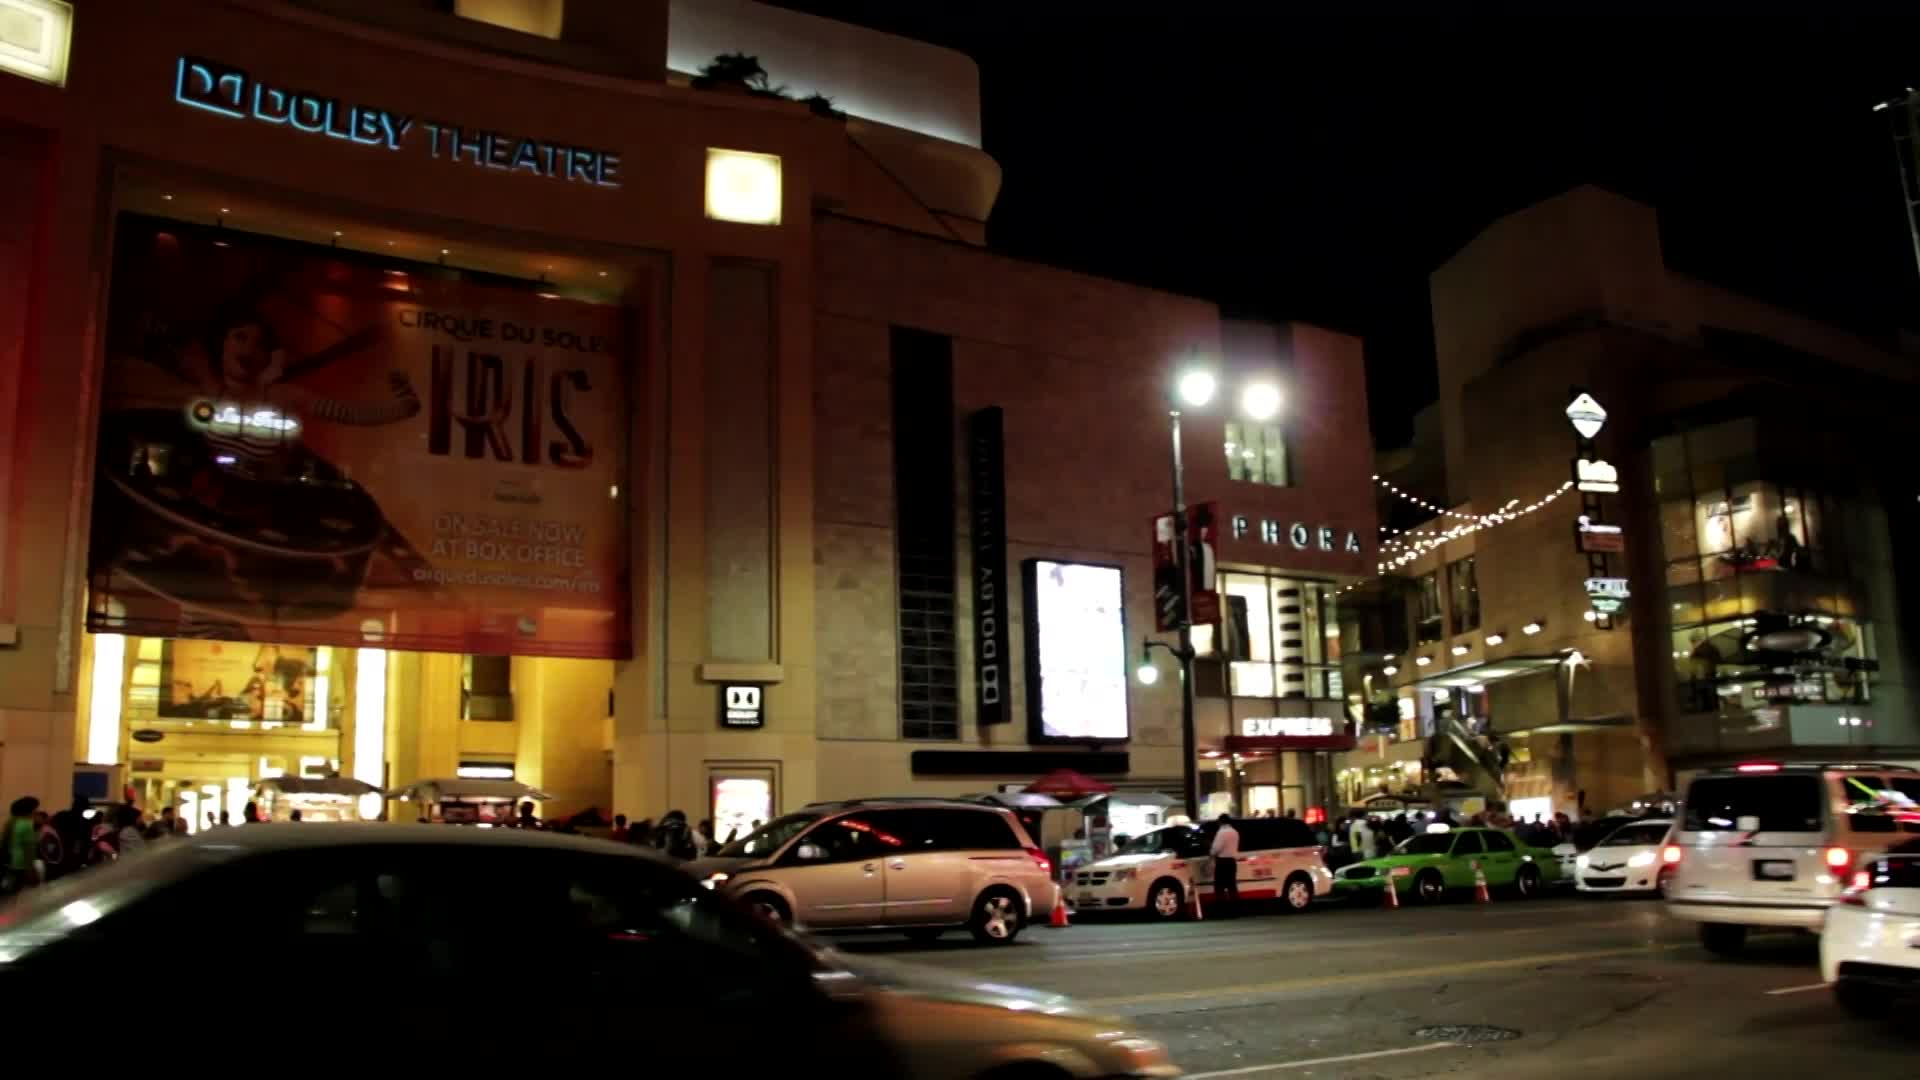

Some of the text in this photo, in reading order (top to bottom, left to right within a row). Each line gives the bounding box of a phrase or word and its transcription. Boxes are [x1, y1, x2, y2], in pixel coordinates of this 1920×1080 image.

[253, 79, 623, 189] DOLBY THEATRE
[399, 308, 607, 353] CIRQUE DU SOLE
[427, 344, 593, 470] IRIS
[434, 513, 465, 537] ON
[528, 520, 585, 546] NOW
[1231, 514, 1361, 553] PHORA
[432, 537, 585, 569] AT BOX OFFICE
[977, 566, 998, 660] DOLBY
